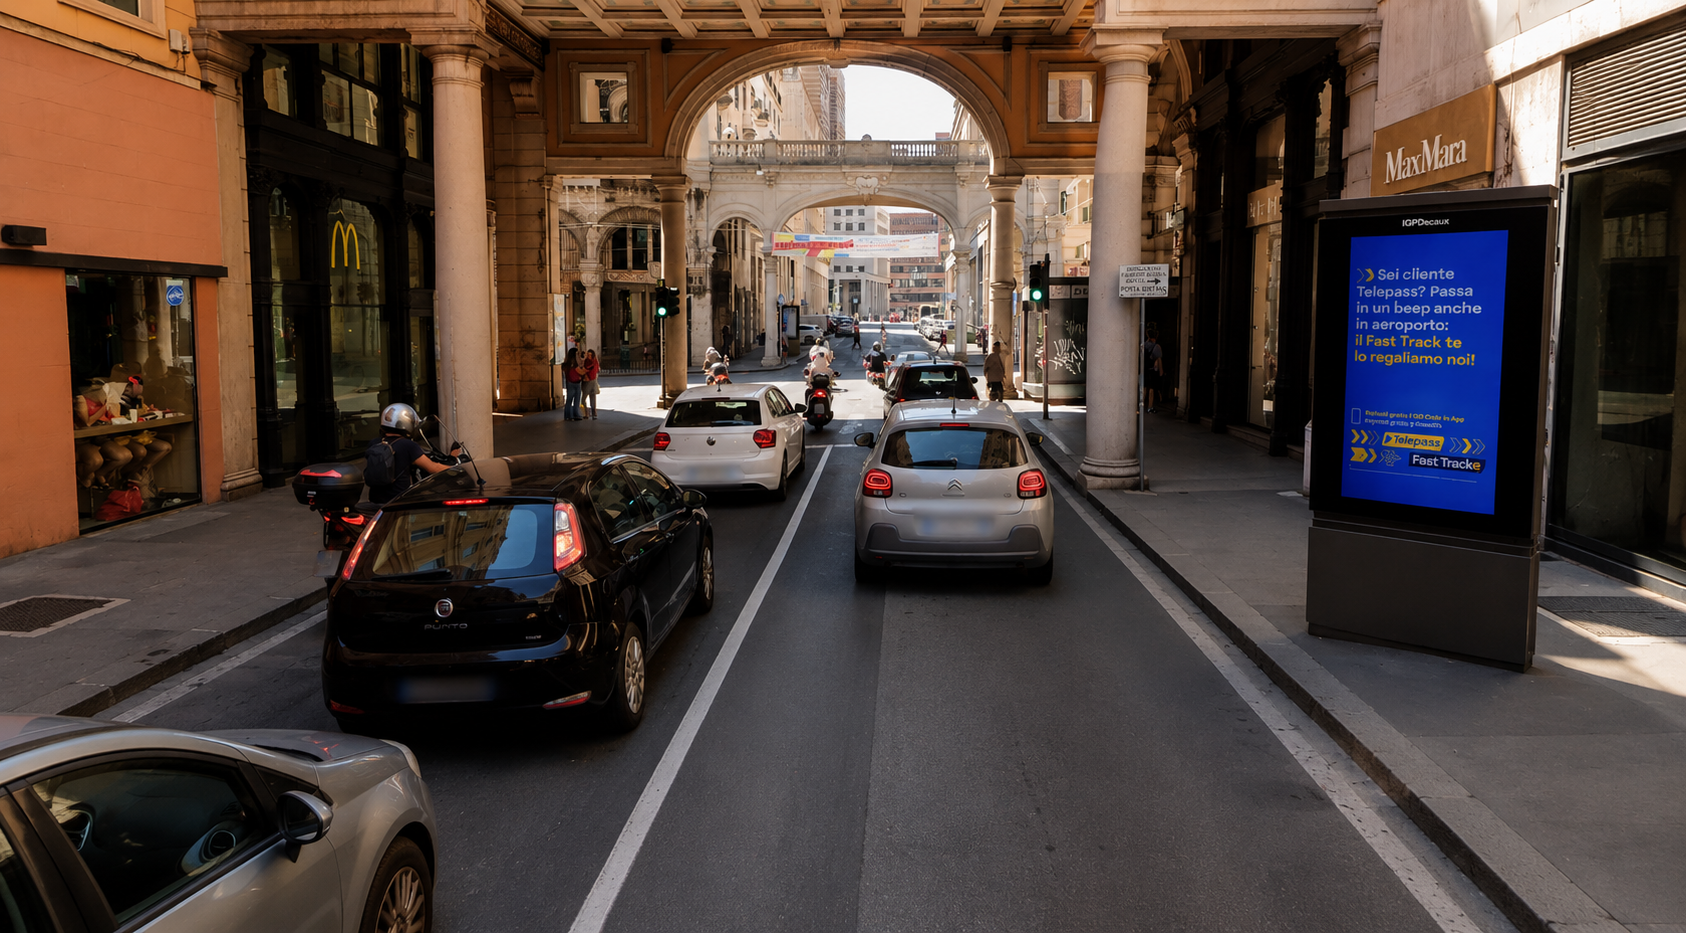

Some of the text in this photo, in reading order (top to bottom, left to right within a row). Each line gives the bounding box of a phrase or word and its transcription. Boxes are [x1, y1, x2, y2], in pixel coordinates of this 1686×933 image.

[1402, 218, 1450, 227] IGPDecaux
[1377, 267, 1455, 280] Sei cliente
[1356, 285, 1474, 300] Telepass? Passa
[1356, 300, 1482, 317] in un beep anche
[1356, 317, 1449, 333] in aeroporto:
[1355, 334, 1462, 348] il Fast Track te
[1354, 350, 1476, 366] lo regaliamo noi!
[1394, 435, 1441, 448] Telepass
